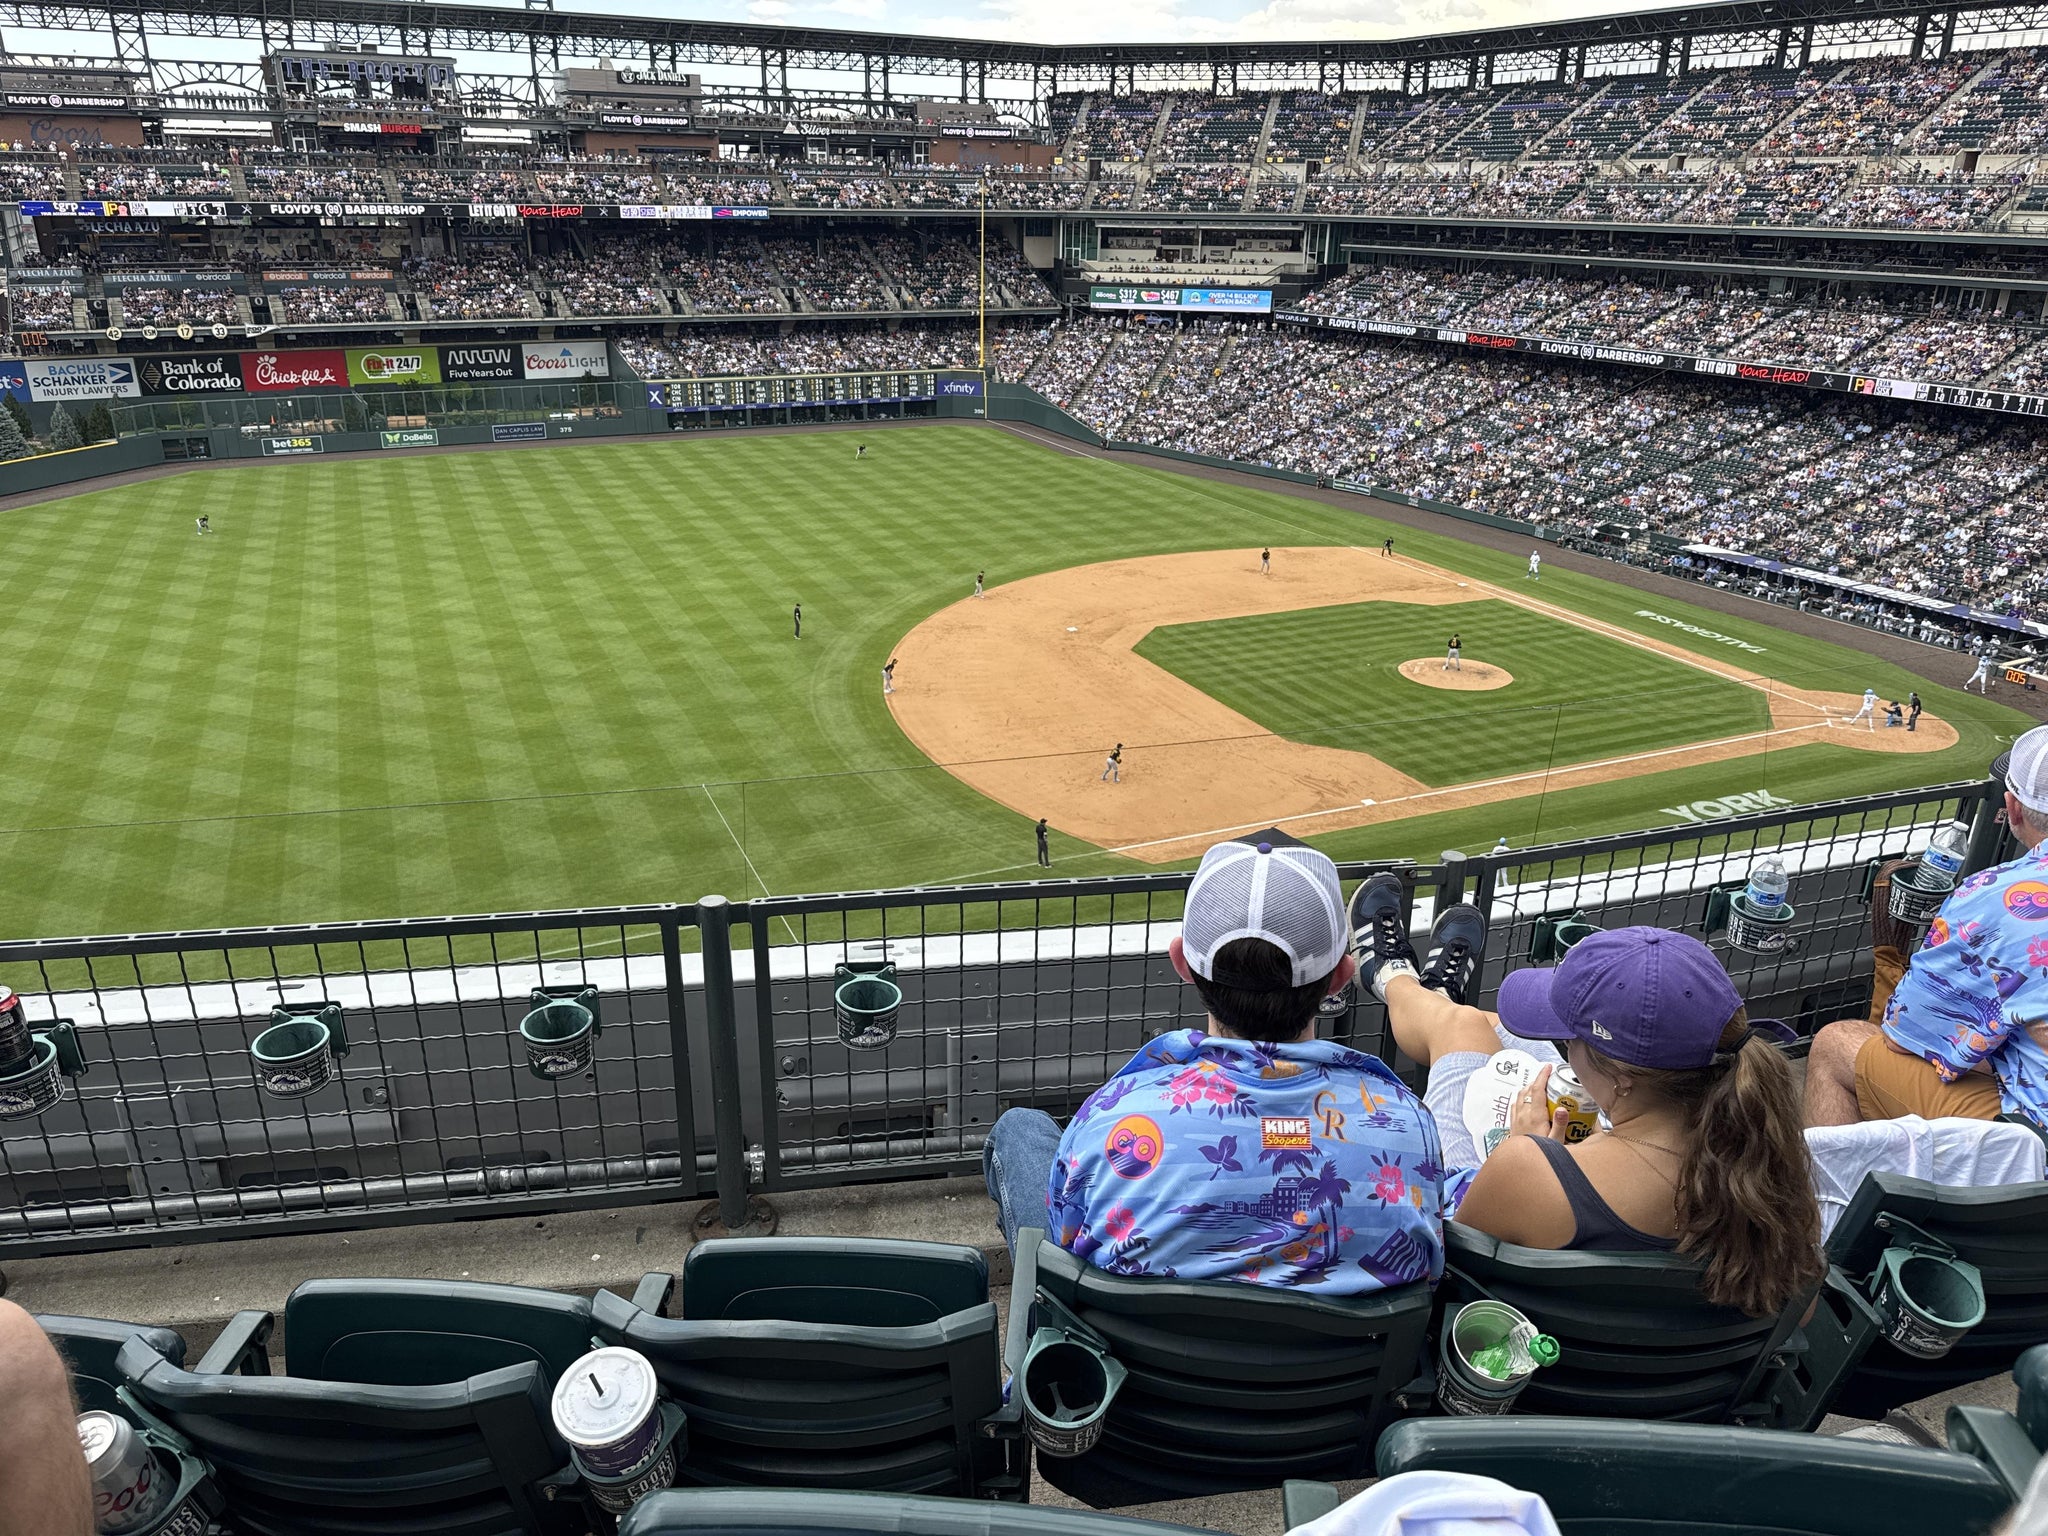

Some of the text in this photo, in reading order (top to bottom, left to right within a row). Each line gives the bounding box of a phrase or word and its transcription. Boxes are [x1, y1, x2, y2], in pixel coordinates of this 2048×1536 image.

[282, 57, 456, 84] THE ROOFTOP
[636, 70, 656, 80] JACK
[8, 96, 125, 106] FLOYD'S BARBERSHOP
[643, 117, 688, 125] BARBERSHOP
[344, 122, 422, 134] SMASHBURGER
[800, 124, 831, 135] Silver
[52, 202, 78, 212] tgrp
[270, 204, 322, 214] FLOYD'S
[345, 205, 425, 215] BARBERSHOP
[469, 205, 483, 217] LET
[494, 205, 506, 217] GO
[506, 206, 517, 217] TO
[1119, 289, 1137, 300] $312
[1329, 318, 1356, 329] FLOYD'S
[1368, 323, 1416, 336] BARBERSHOP
[448, 349, 511, 365] ARROW
[1540, 342, 1578, 355] FLOYD'S
[1596, 346, 1664, 365] BARBERSHOP
[161, 358, 223, 375] Bank of
[366, 357, 420, 370] Fix-it 24/7
[526, 354, 606, 369] Coors LIGHT
[48, 364, 105, 375] BACHUS
[449, 368, 513, 378] Five Years Out
[1694, 360, 1707, 373] LET
[1726, 364, 1736, 376] TO
[32, 375, 107, 387] SCHANKER
[165, 376, 241, 390] Colorado
[43, 385, 128, 396] INJURY LAWYERS
[944, 382, 975, 394] xfinity
[1934, 393, 1944, 401] 1-0
[1953, 395, 1969, 404] 1.97
[1976, 398, 1992, 408] 32.0
[2034, 405, 2044, 414] 11
[272, 438, 312, 448] bet365
[403, 433, 432, 441] DaBella
[1649, 615, 1768, 653] TALLGRASS
[2006, 670, 2026, 685] 0:05
[2007, 773, 2020, 796] STIHL
[1658, 789, 1793, 822] YORK
[1313, 1090, 1348, 1143] CR
[1265, 1120, 1307, 1134] KING
[1266, 1133, 1307, 1147] Soopers
[628, 1450, 671, 1497] COORS
